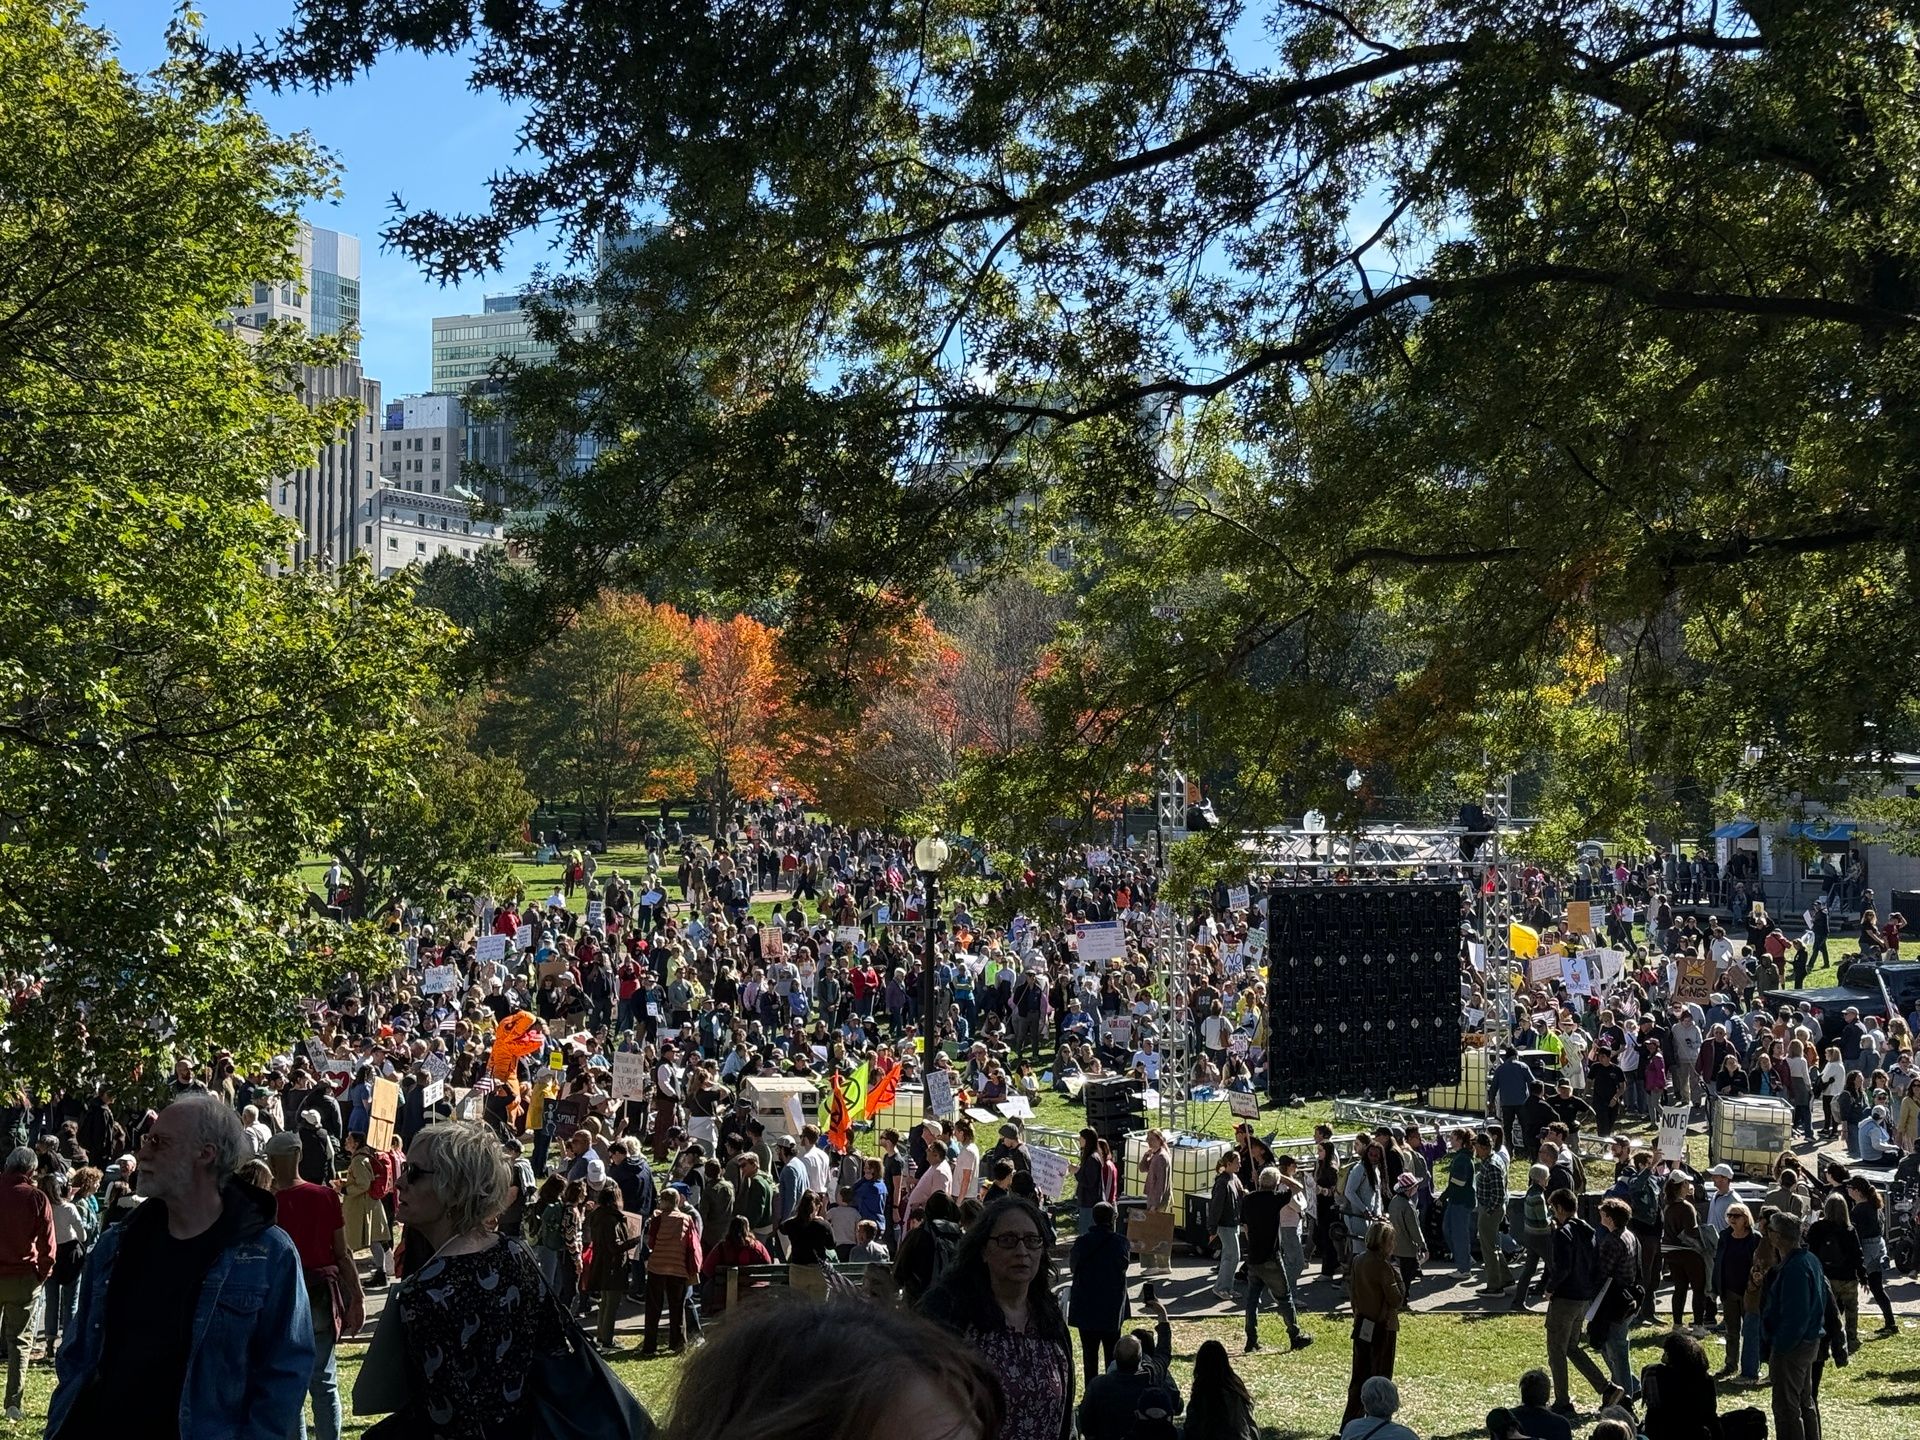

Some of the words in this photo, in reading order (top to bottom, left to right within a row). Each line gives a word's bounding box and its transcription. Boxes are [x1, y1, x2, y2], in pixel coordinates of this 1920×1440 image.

[1225, 953, 1242, 965] NO
[427, 968, 444, 976] STAND
[445, 967, 453, 976] UP
[426, 981, 443, 991] MAFIA
[1681, 976, 1706, 986] NO
[557, 1113, 577, 1125] SPINE
[1662, 1113, 1680, 1129] NOT
